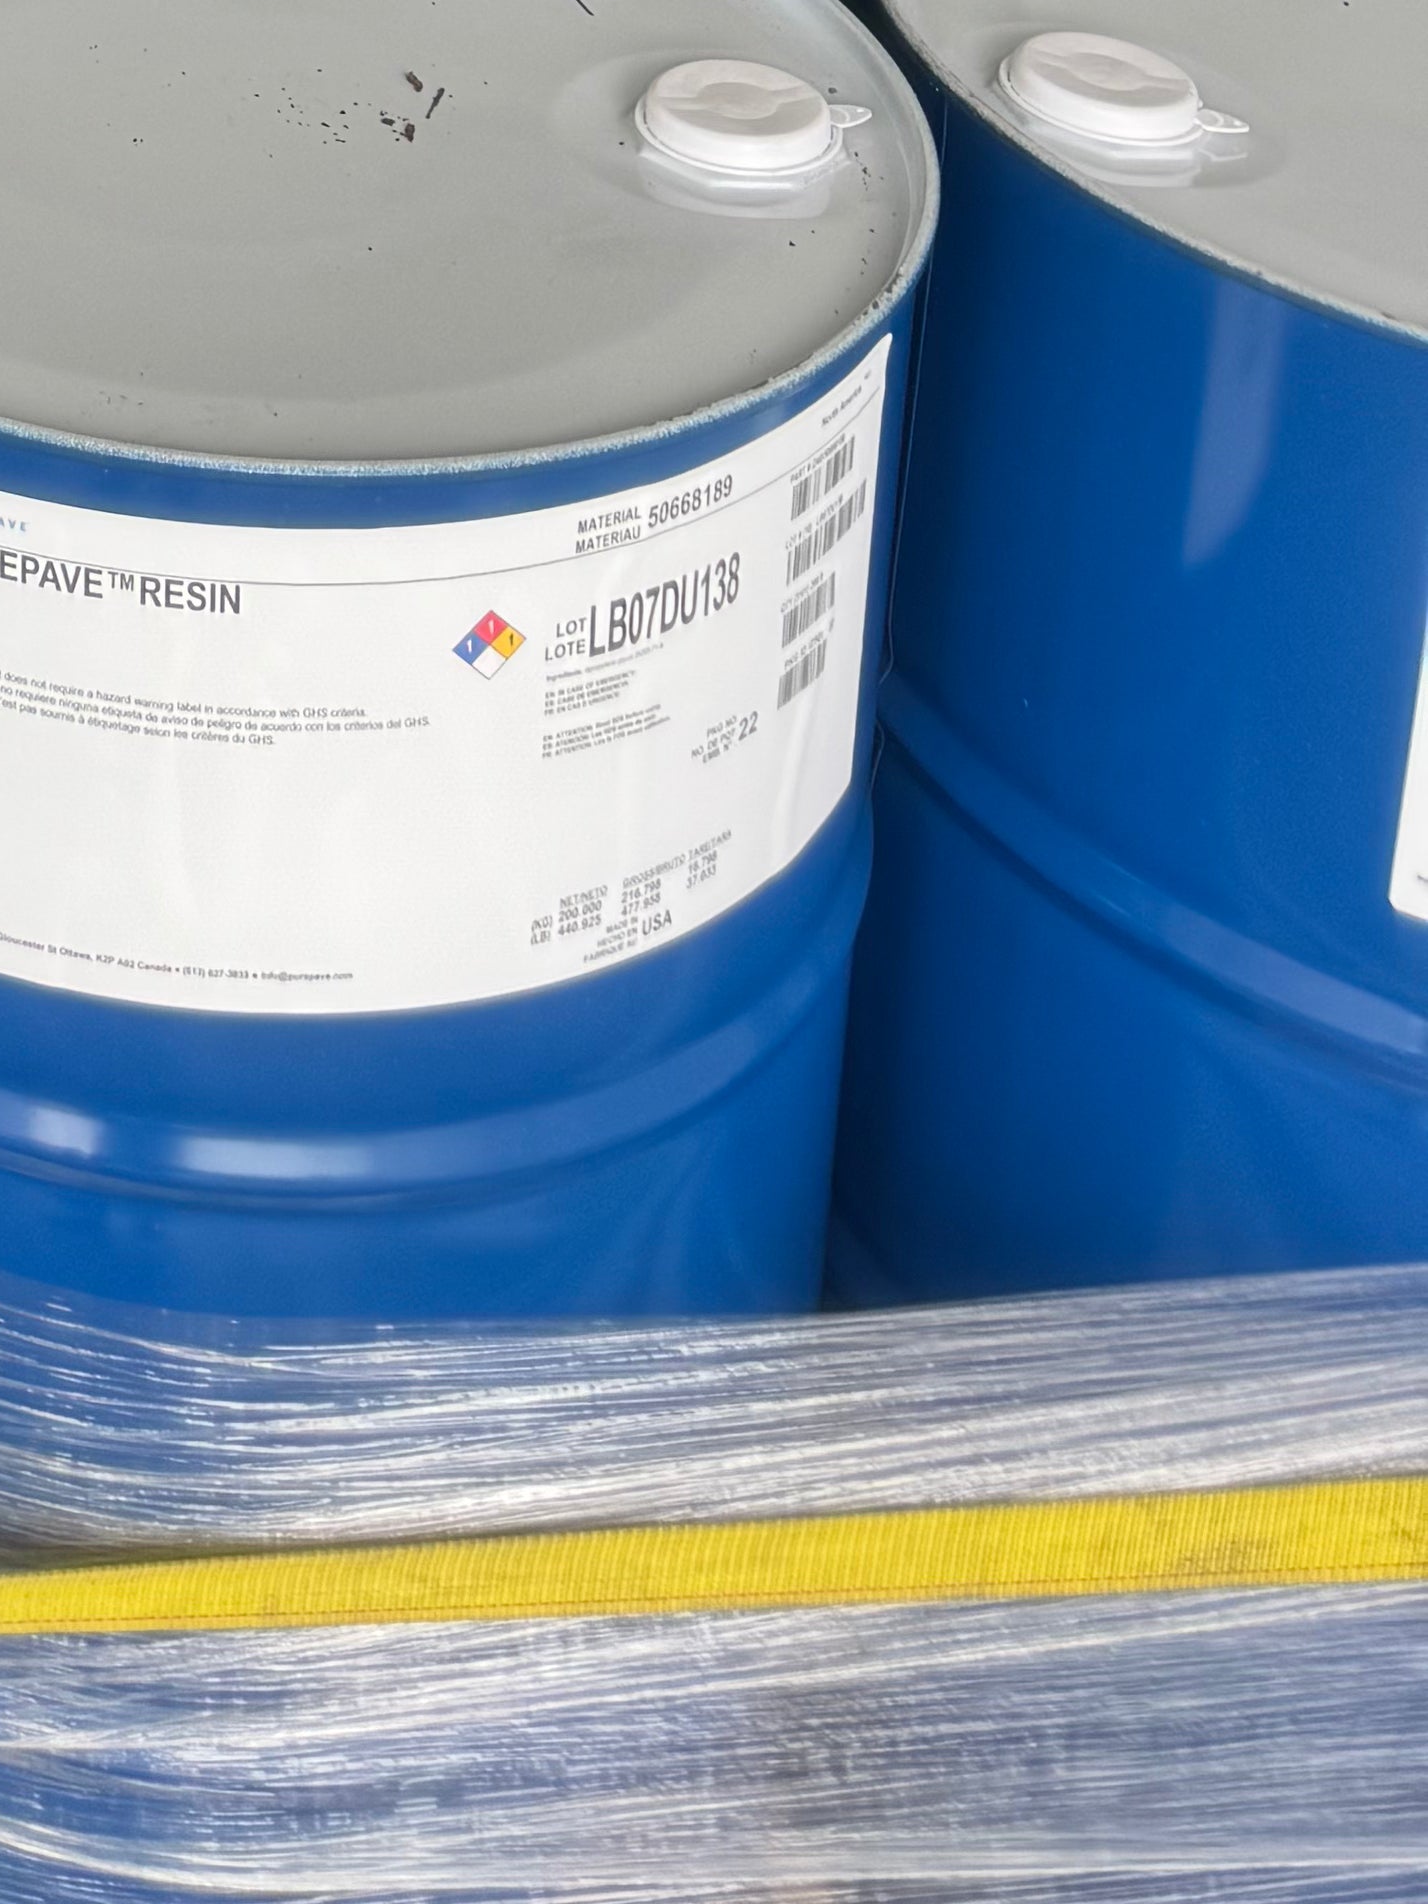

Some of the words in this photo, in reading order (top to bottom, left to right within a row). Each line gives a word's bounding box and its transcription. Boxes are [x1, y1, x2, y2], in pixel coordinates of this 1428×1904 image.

[648, 474, 733, 528] 50668189
[577, 506, 642, 535] MATERIAL
[575, 525, 641, 554] MATERIAU
[140, 576, 241, 614] RESIN
[589, 552, 740, 657] LB07DU138
[556, 617, 587, 638] LOT
[545, 639, 586, 662] LOTE
[738, 711, 758, 741] 22
[641, 909, 672, 936] USA
